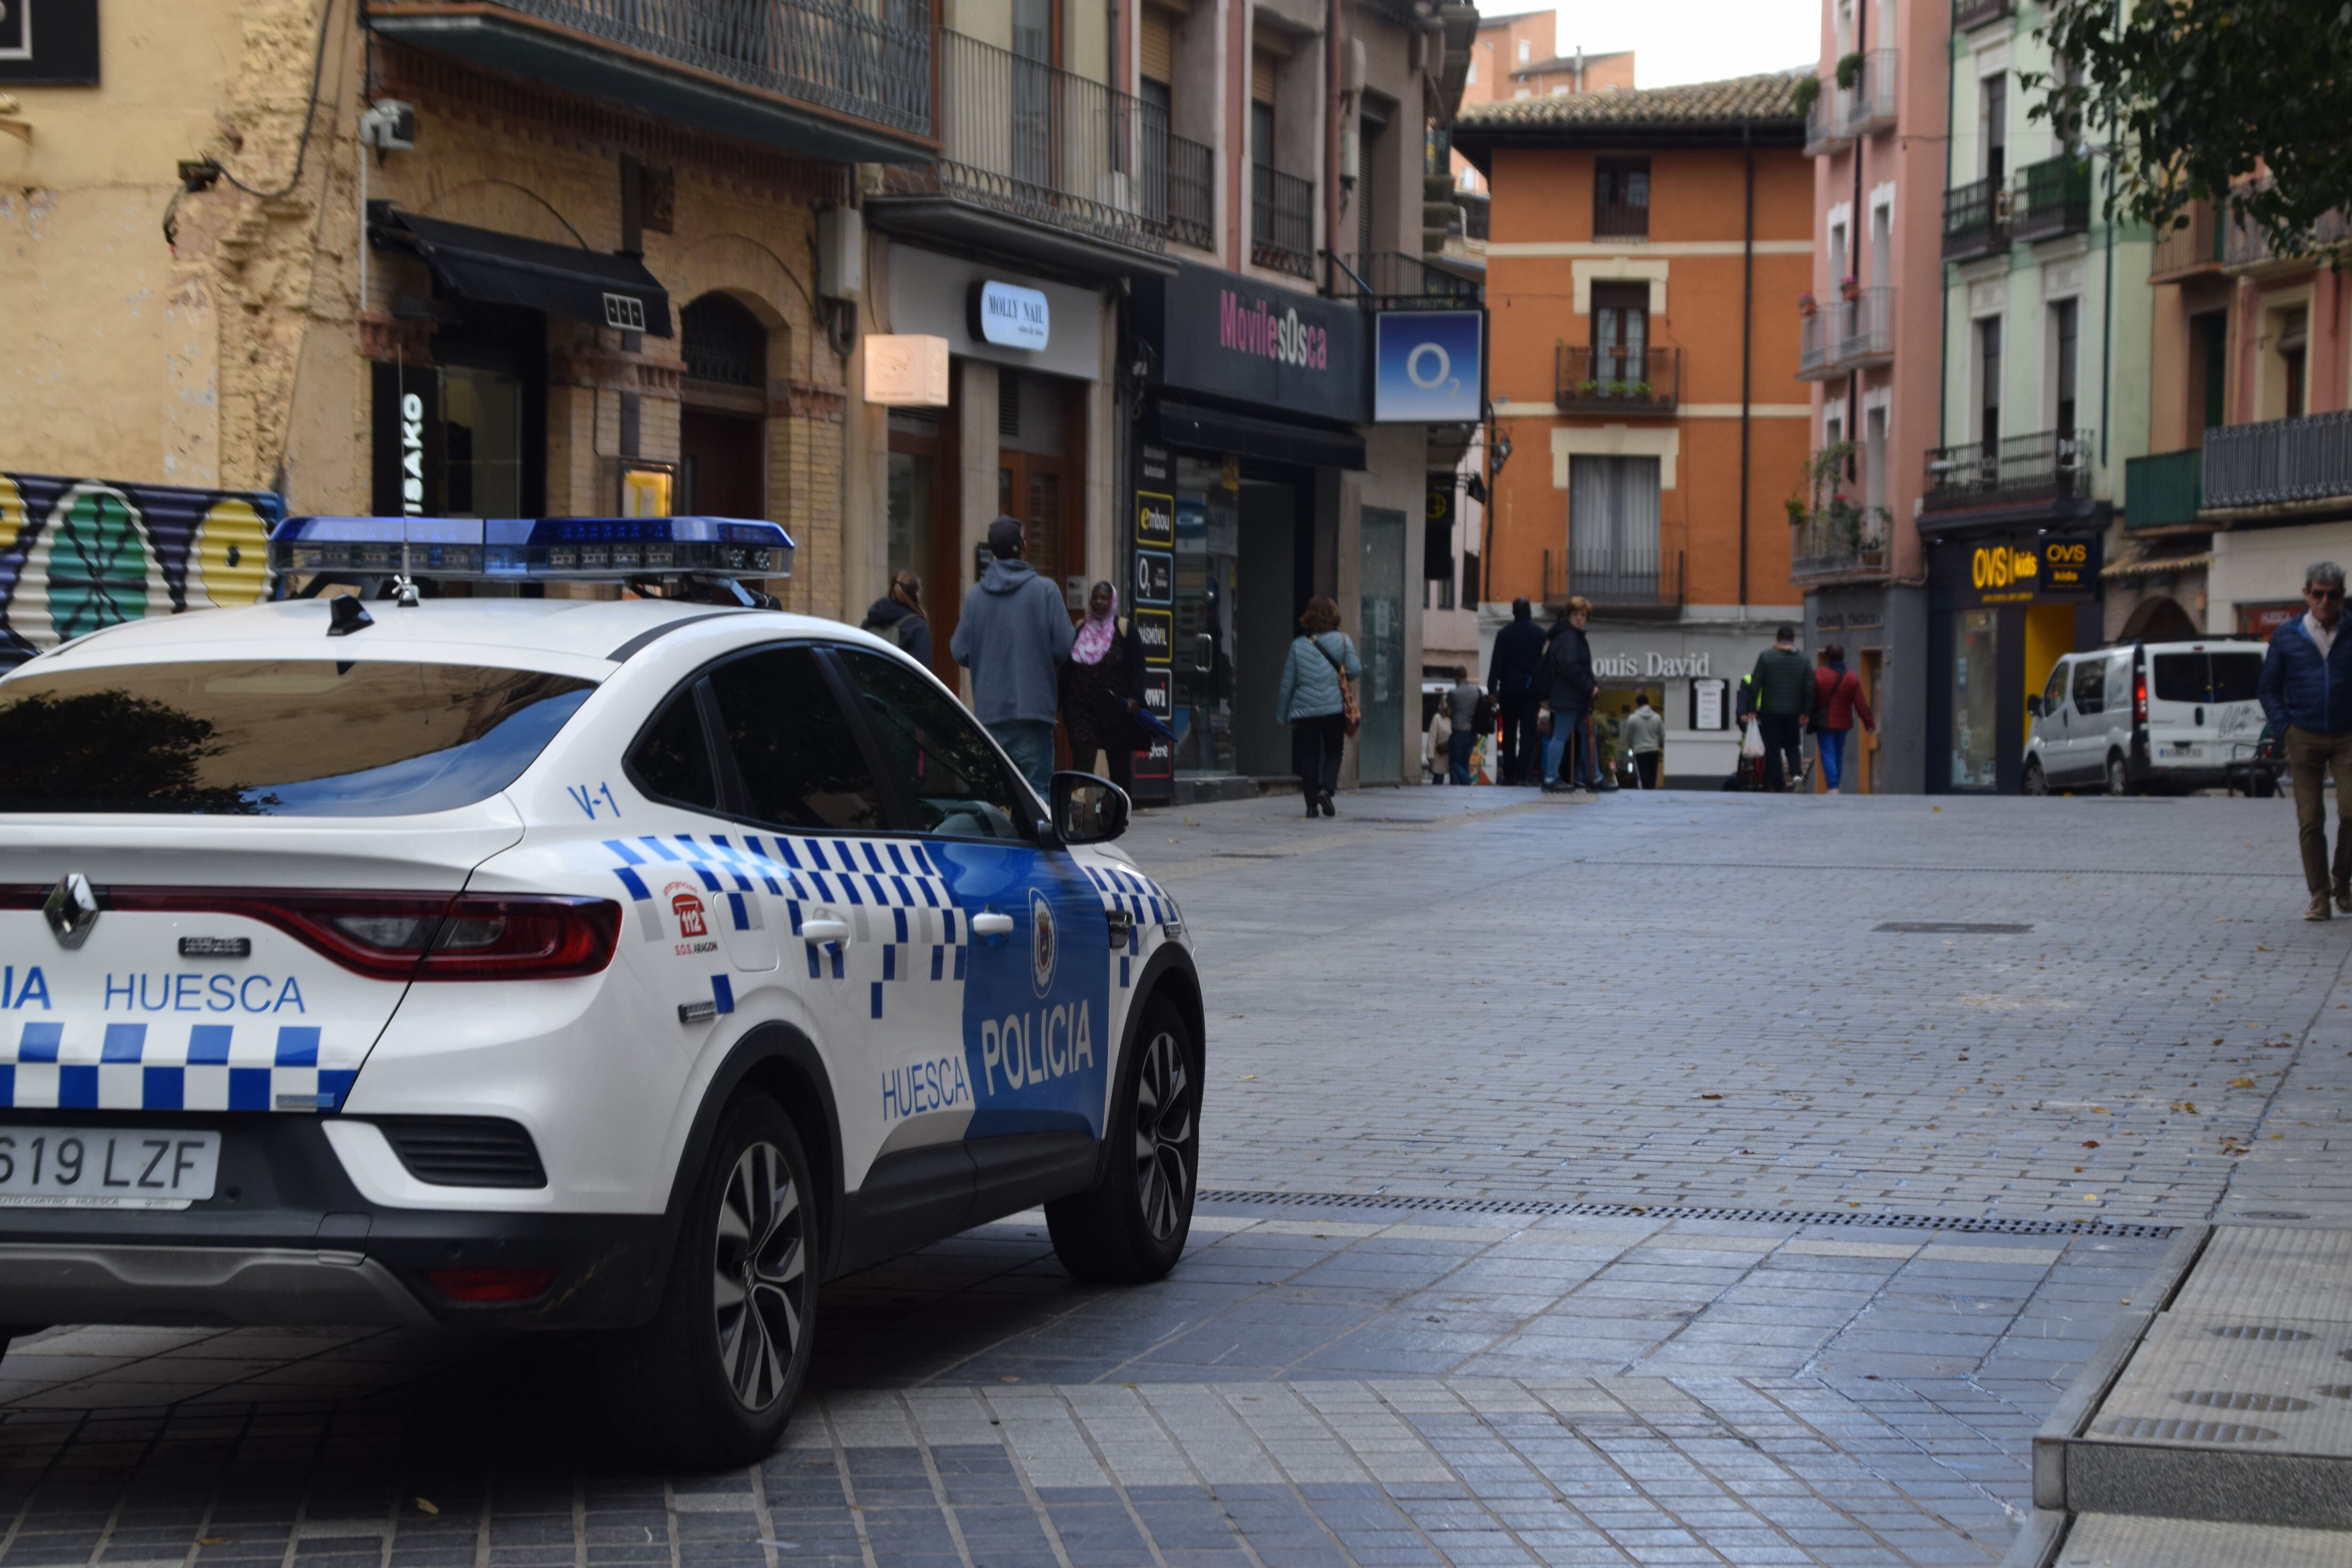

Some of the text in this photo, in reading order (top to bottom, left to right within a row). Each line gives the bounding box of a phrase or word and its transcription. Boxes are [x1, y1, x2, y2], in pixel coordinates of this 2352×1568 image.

[989, 294, 1044, 324] MOLLY NAIL
[403, 393, 423, 517] ISAKO
[1141, 506, 1170, 531] embou
[1973, 547, 2038, 589] OVS kids
[2046, 544, 2087, 562] OVS
[2053, 570, 2079, 582] kids
[1592, 652, 1711, 677] ouis David
[1145, 681, 1166, 708] owi
[567, 781, 620, 820] V-1
[682, 909, 702, 933] 112
[103, 973, 306, 1013] HUESCA
[982, 999, 1094, 1096] POLICIA
[882, 1056, 969, 1121] HUESCA
[103, 1138, 205, 1188] LZF
[75, 1196, 118, 1205] HUESCA
